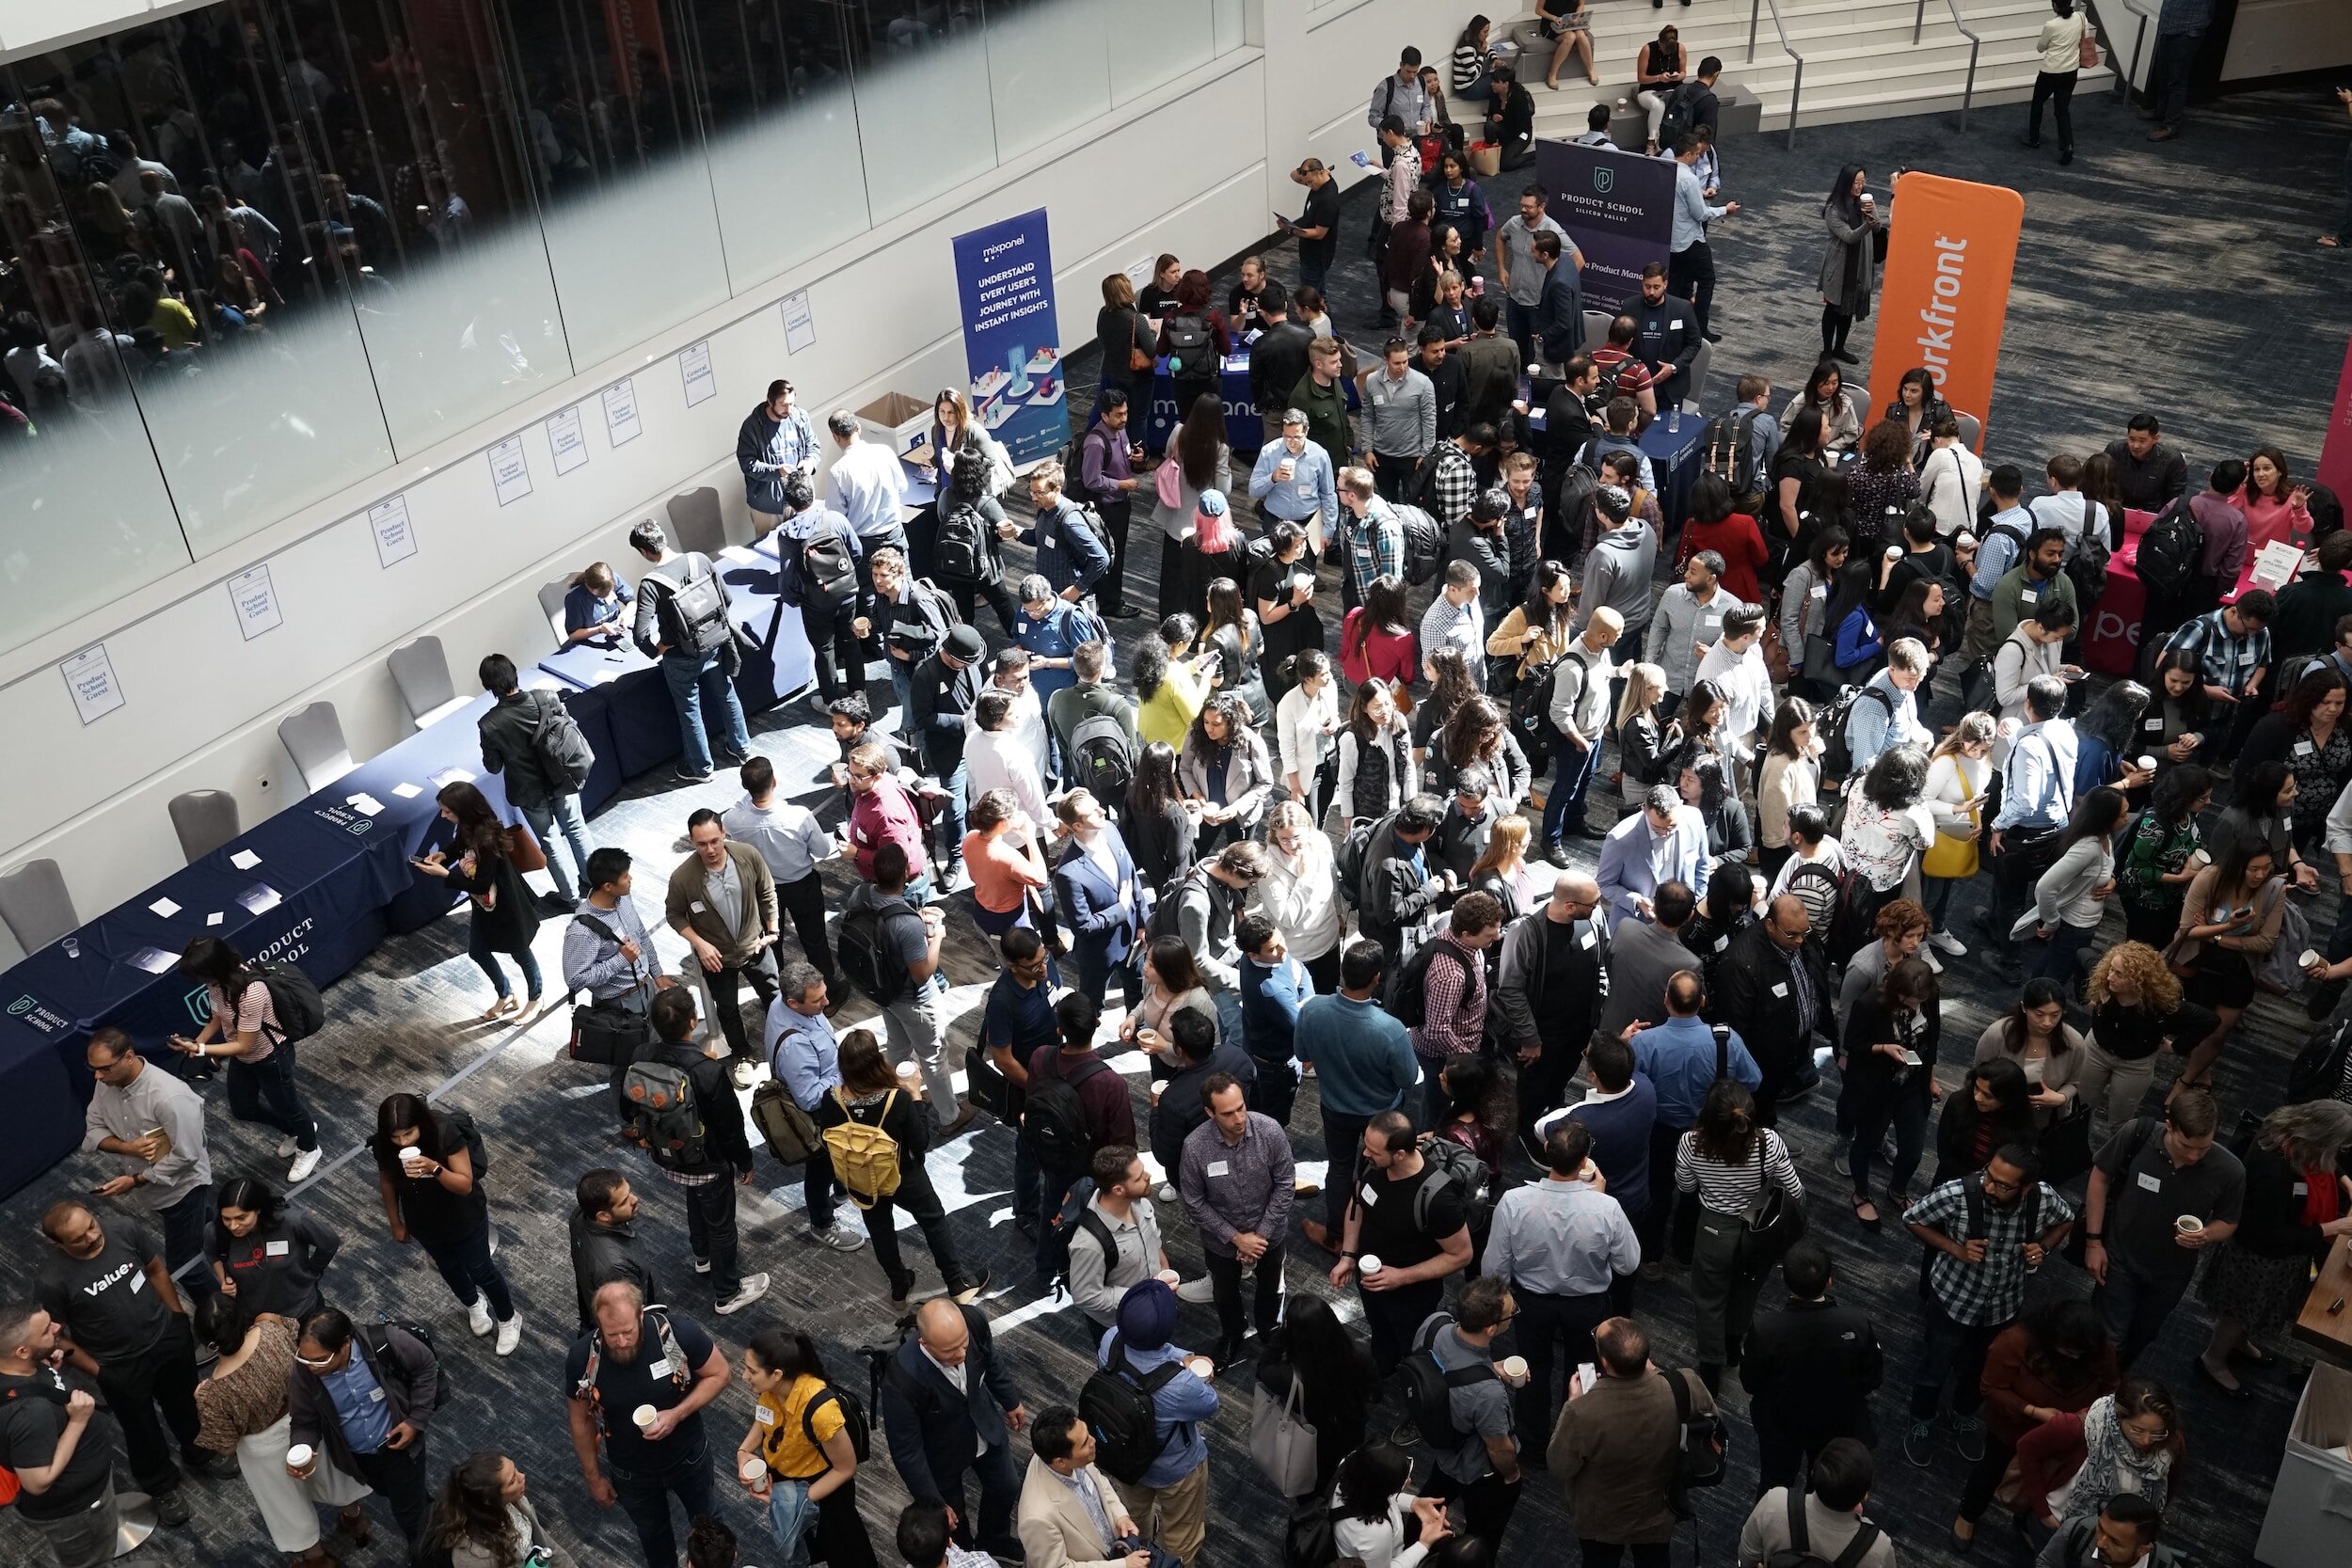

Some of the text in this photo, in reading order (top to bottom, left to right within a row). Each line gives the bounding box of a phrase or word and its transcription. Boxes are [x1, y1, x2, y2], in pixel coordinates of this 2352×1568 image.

[1562, 193, 1645, 215] PRODUCT SCHOOL
[1575, 208, 1628, 222] SILICON VALLEY
[983, 234, 1025, 257] mixpanel
[978, 262, 1035, 288] UNDERSTAND
[1591, 262, 1620, 276] Product
[1621, 269, 1644, 280] Mana
[980, 277, 1037, 302] EVERY USER'S
[979, 289, 1041, 316] JOURNEY WITH
[975, 300, 1048, 332] INSTANT INSIGHTS
[612, 404, 630, 416] Product
[557, 432, 575, 443] Product
[500, 461, 518, 473] Product
[502, 467, 518, 477] School
[497, 470, 525, 486] Community
[380, 521, 405, 536] Product
[384, 528, 405, 541] School
[386, 534, 405, 547] Guest
[241, 591, 268, 608] Product
[246, 597, 268, 612] School
[248, 605, 269, 619] Guest
[77, 672, 107, 690] Product
[82, 678, 107, 696] School
[86, 687, 108, 701] Guest
[314, 810, 347, 826] PRODUCT
[328, 807, 356, 820] SCHOOL
[24, 1014, 54, 1032] SCHOOL
[35, 1006, 69, 1028] PRODUCT
[84, 1262, 134, 1296] Value.
